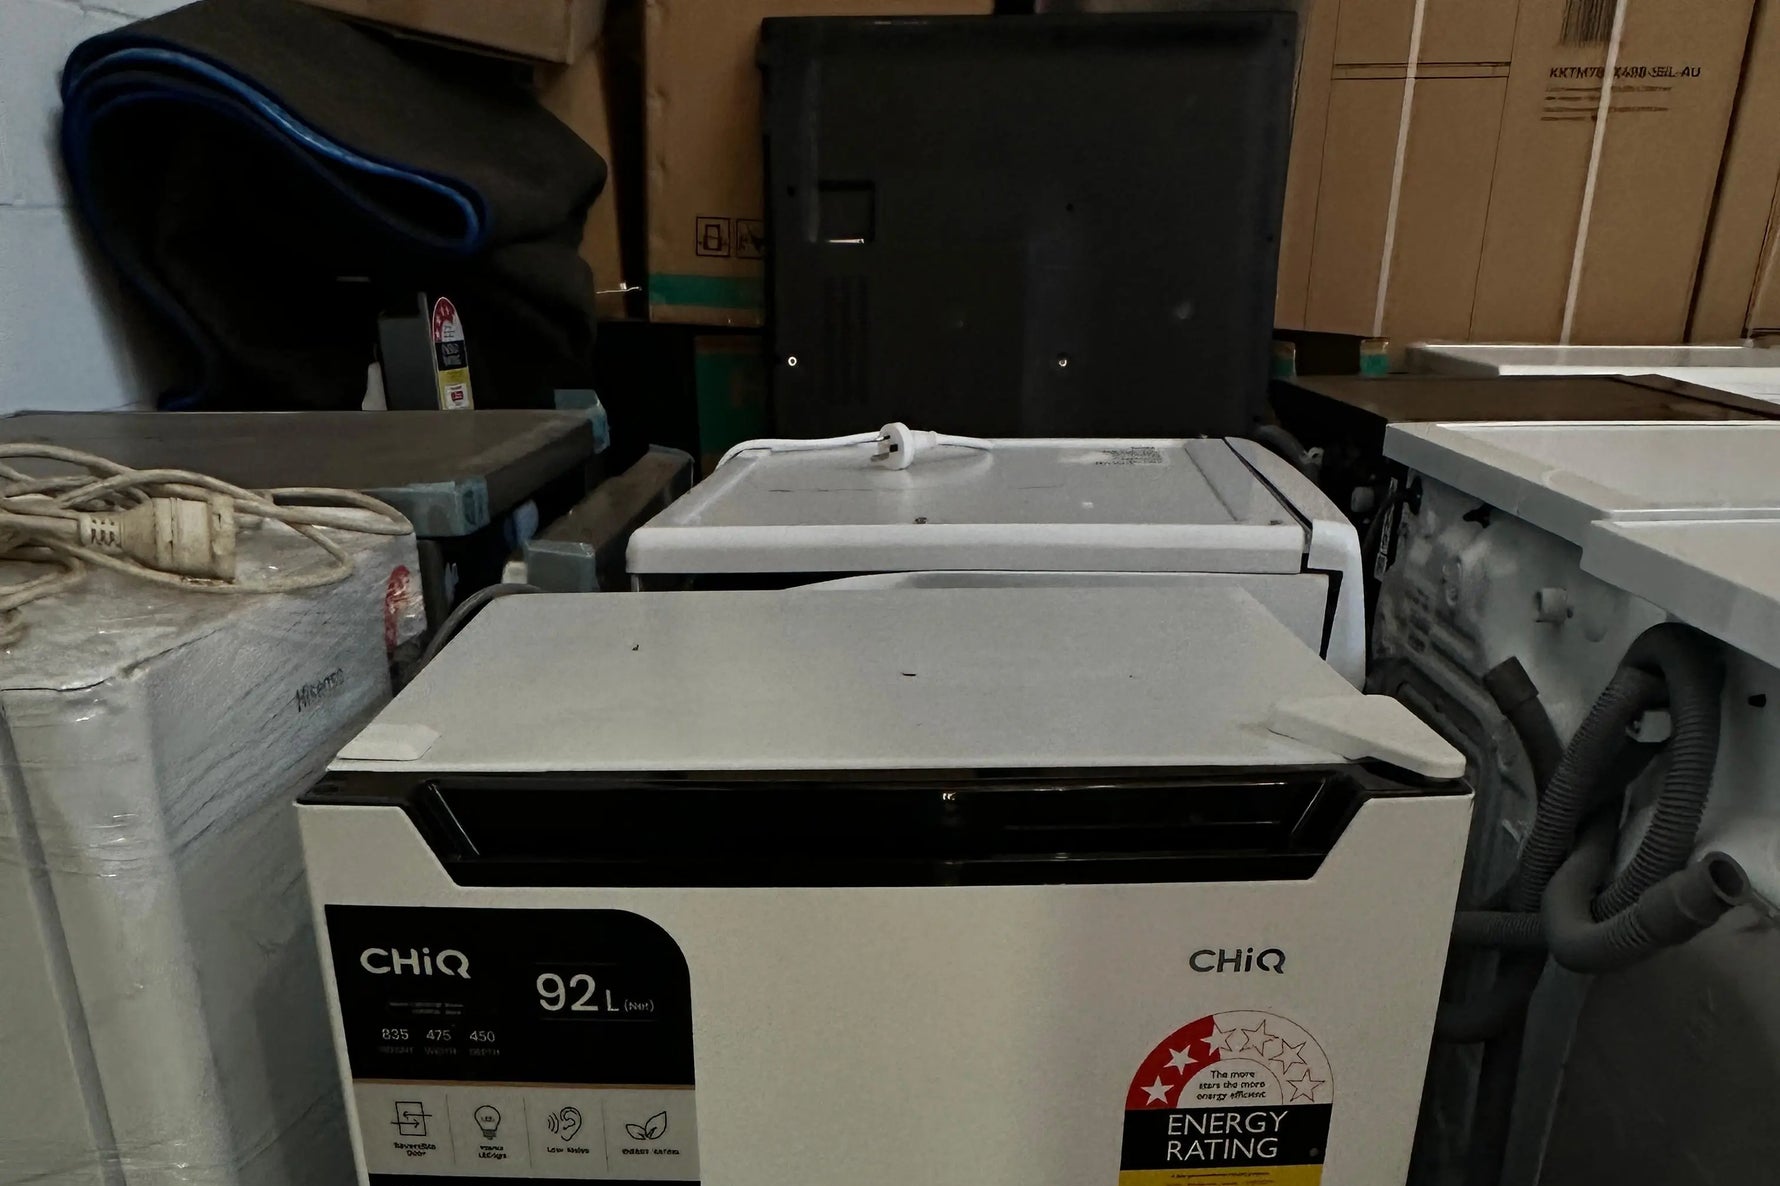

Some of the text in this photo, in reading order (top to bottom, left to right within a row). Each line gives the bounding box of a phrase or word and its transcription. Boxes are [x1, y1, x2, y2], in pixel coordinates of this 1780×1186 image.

[360, 947, 471, 979] CHiQ
[1189, 947, 1286, 975] CHiQ
[382, 1028, 496, 1043] 835 475 450
[1230, 1071, 1255, 1079] more
[1167, 1110, 1288, 1136] ENERGY
[1166, 1137, 1279, 1162] RATING
